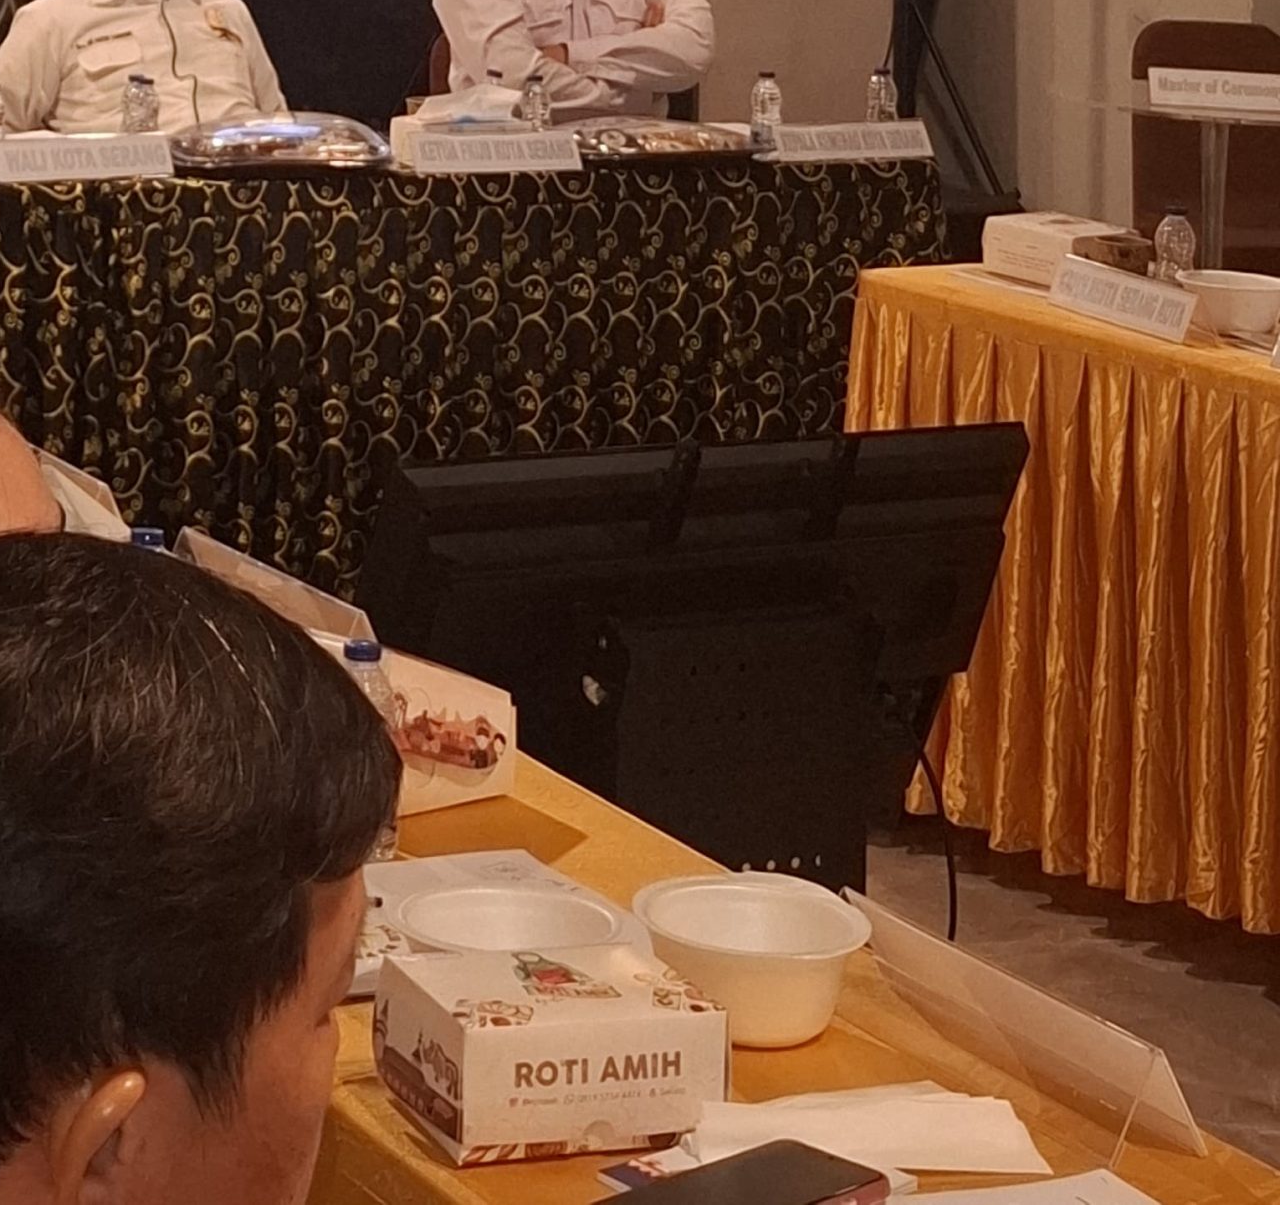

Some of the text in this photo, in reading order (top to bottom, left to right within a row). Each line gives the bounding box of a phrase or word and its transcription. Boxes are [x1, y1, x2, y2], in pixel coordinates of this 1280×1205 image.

[50, 147, 97, 170] KOTA
[98, 144, 168, 169] SERANG
[514, 1050, 682, 1089] ROTI AMIH
